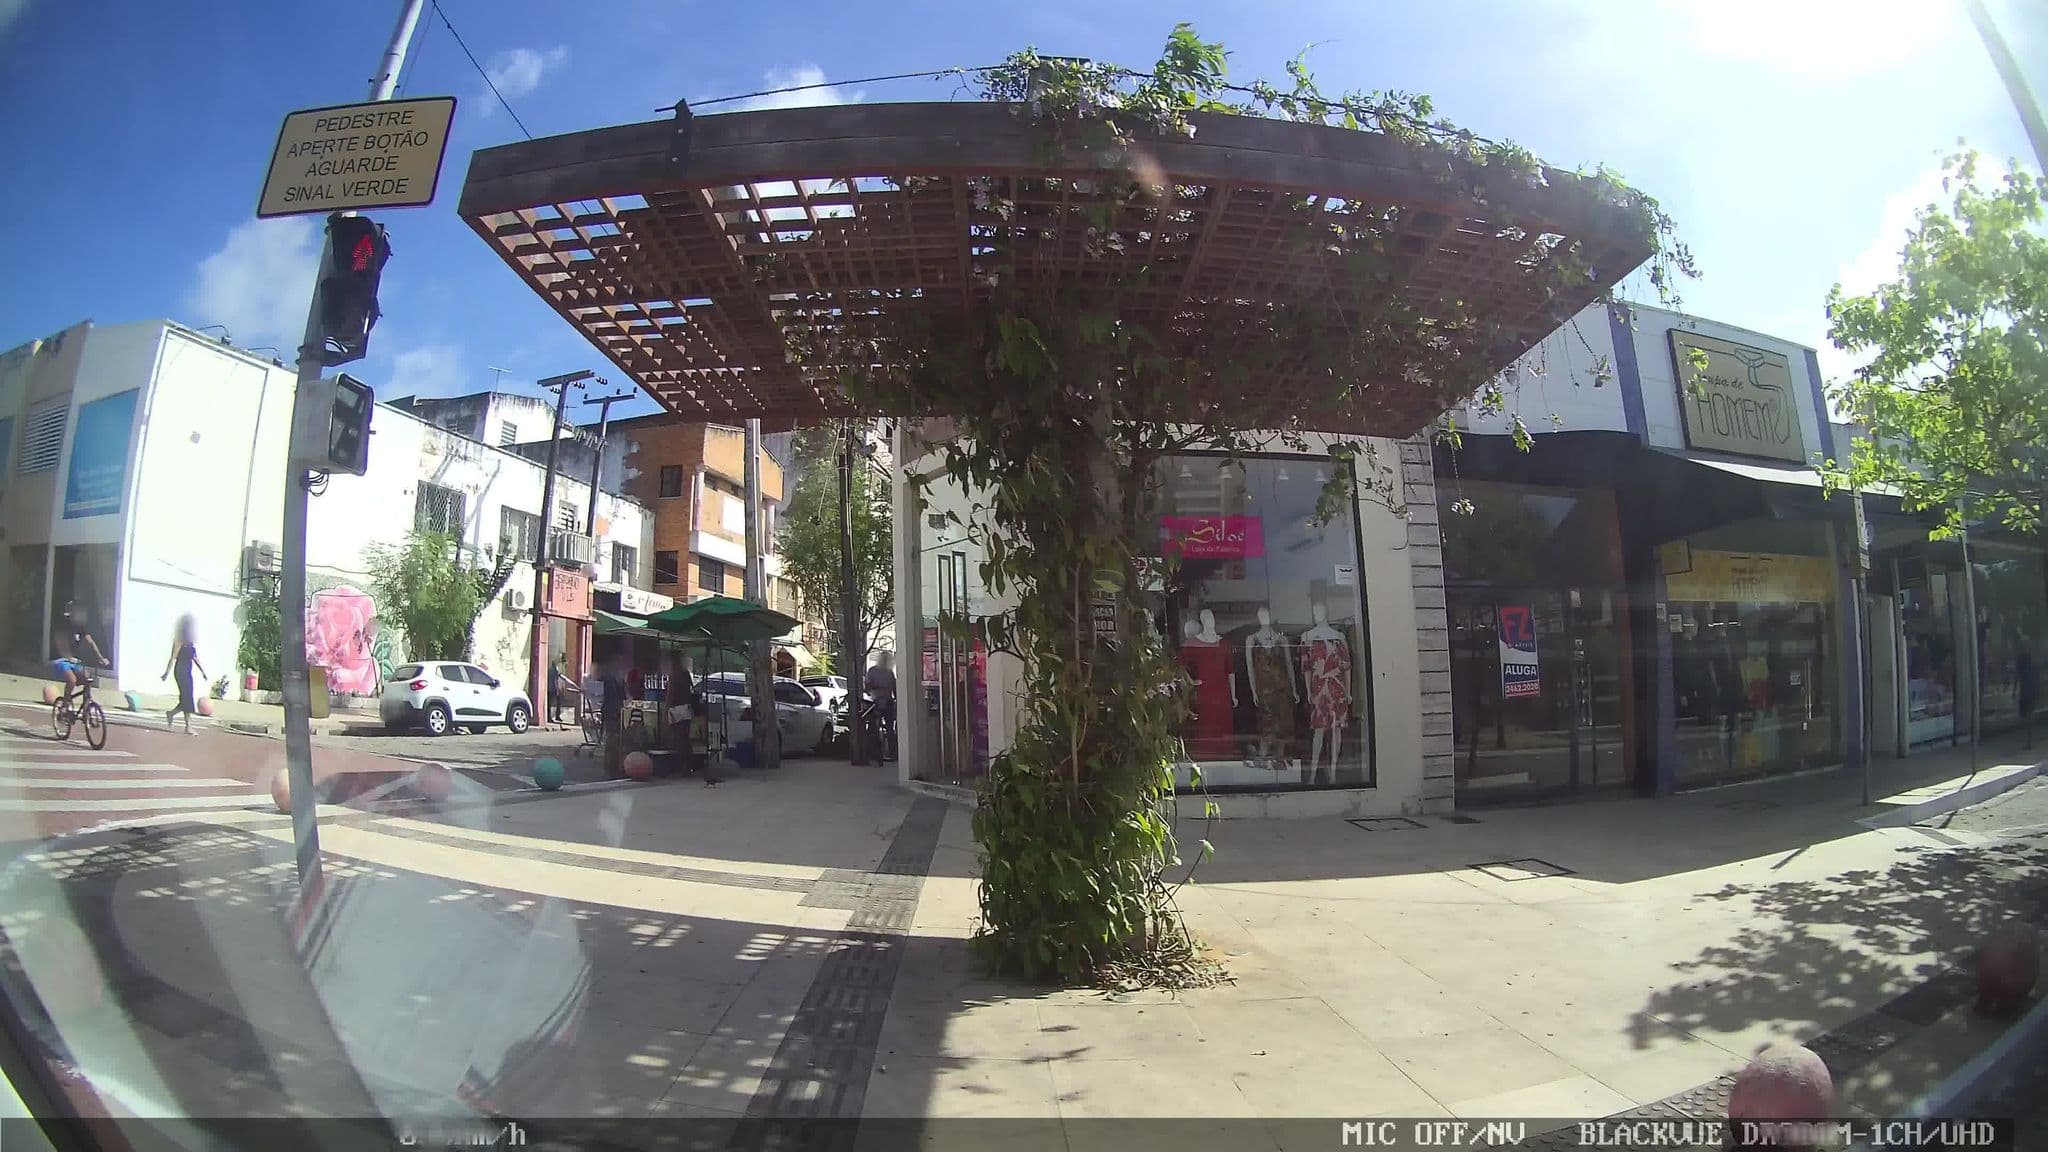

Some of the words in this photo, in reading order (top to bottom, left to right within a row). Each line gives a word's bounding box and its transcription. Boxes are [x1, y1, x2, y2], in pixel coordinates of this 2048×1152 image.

[315, 110, 415, 132] PEDESTRE
[287, 136, 359, 157] APERTE
[363, 130, 429, 149] BOTÃO
[305, 156, 399, 177] AGUARDE
[284, 184, 334, 201] SINAL
[343, 178, 409, 197] VERDE
[1695, 391, 1776, 445] HOMEM
[1505, 665, 1537, 676] ALUGA
